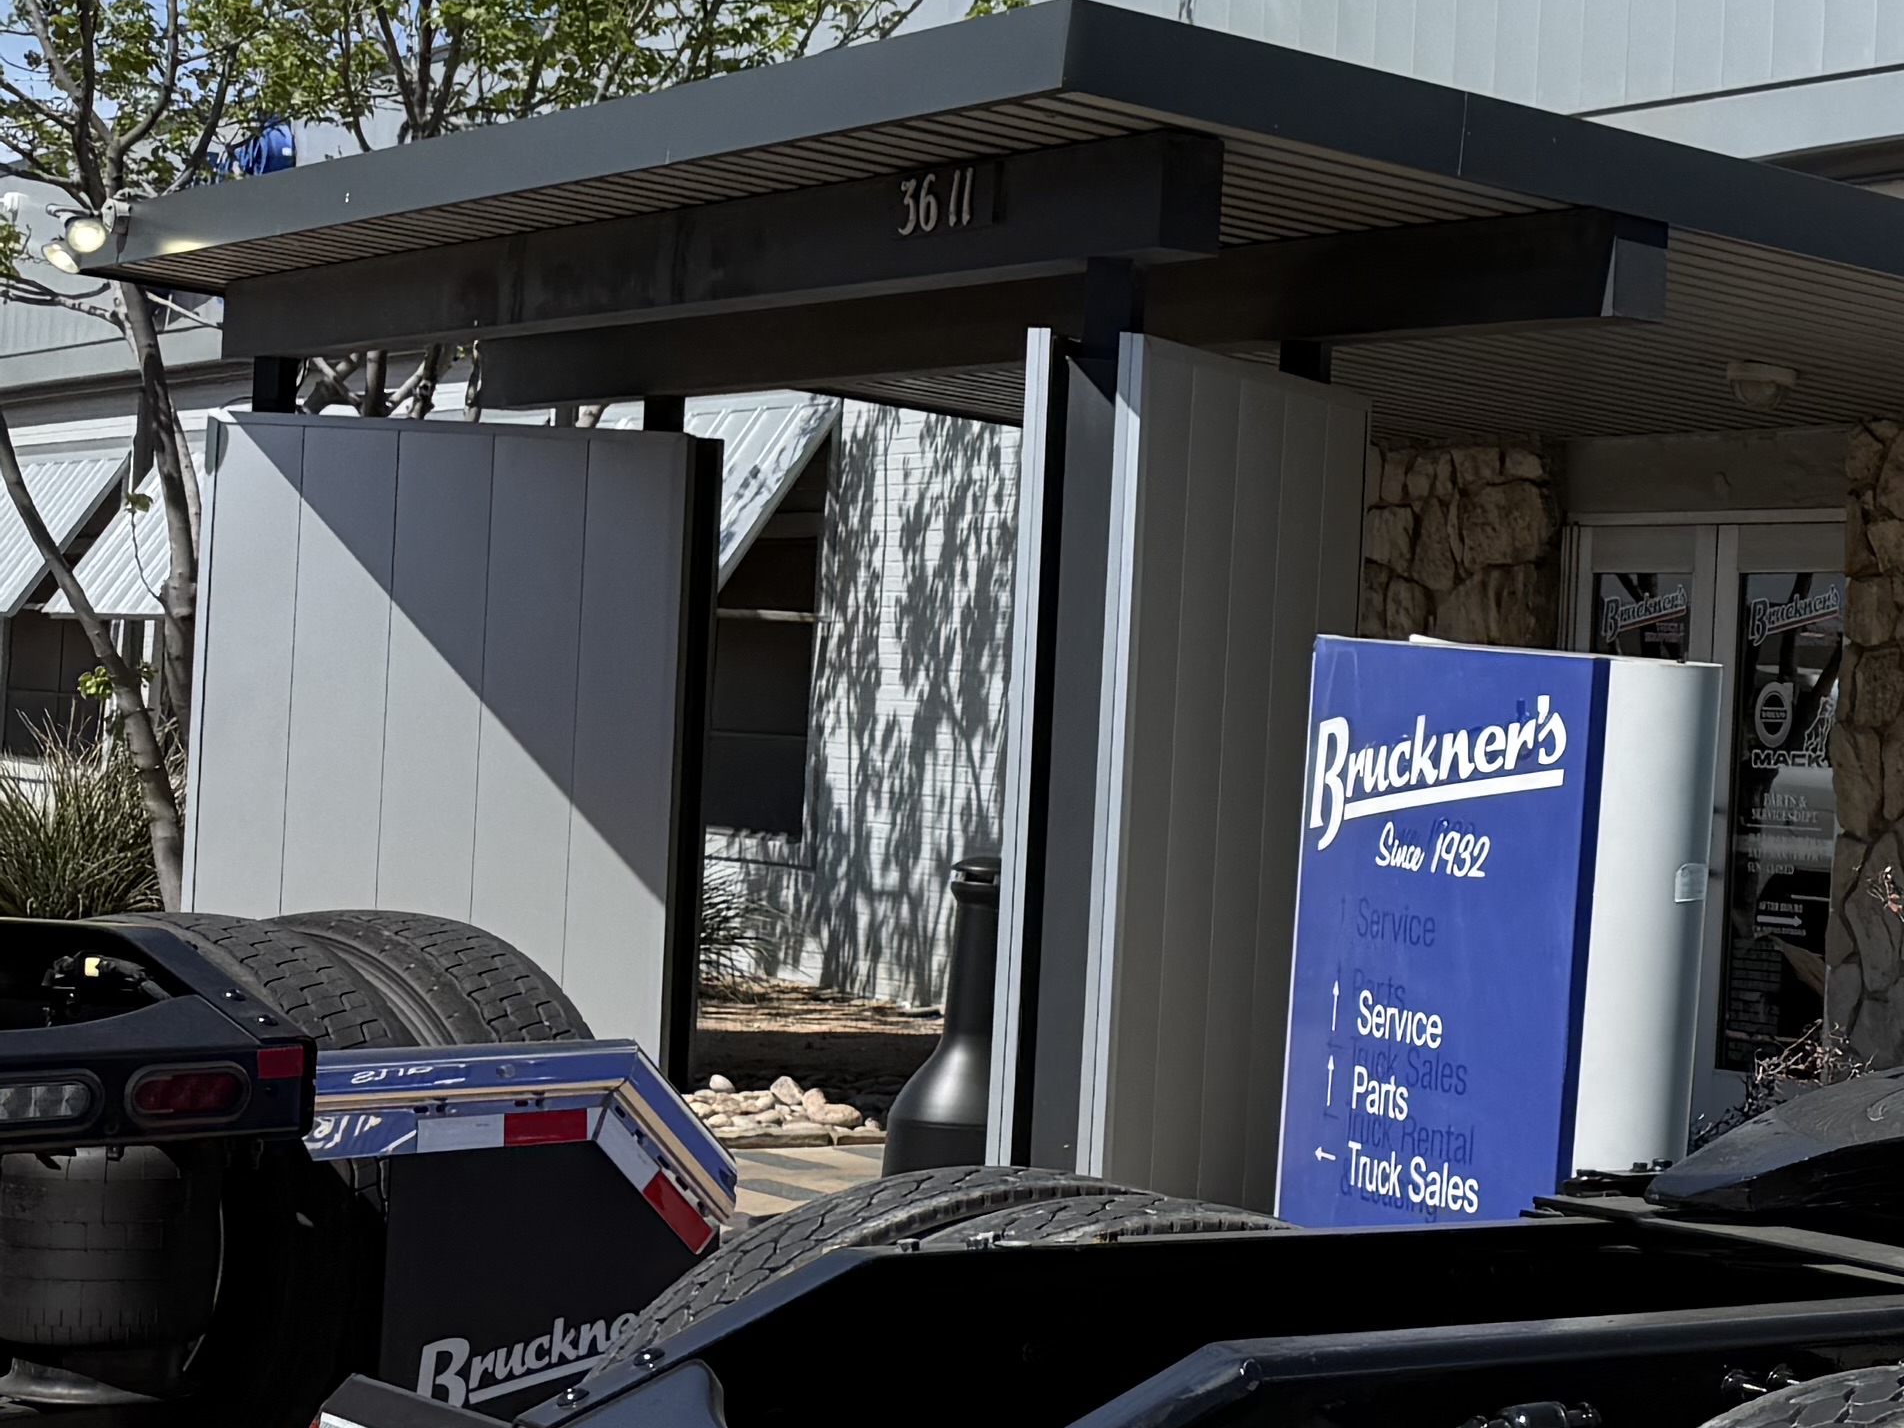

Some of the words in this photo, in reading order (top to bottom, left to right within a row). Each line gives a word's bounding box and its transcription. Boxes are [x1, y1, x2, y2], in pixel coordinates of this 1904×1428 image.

[897, 166, 975, 236] 3611
[1601, 583, 1687, 644] Bruckner's
[1748, 583, 1840, 647] Bruckner's
[1309, 695, 1567, 851] Bruckner's
[1751, 749, 1826, 769] MACK
[1375, 821, 1425, 872] Since
[1430, 830, 1491, 878] 1932
[1357, 895, 1437, 948] Service
[1356, 989, 1444, 1050] Service
[1350, 1064, 1410, 1122] Parts
[1347, 1140, 1402, 1199] Truck
[1407, 1155, 1480, 1214] Sales
